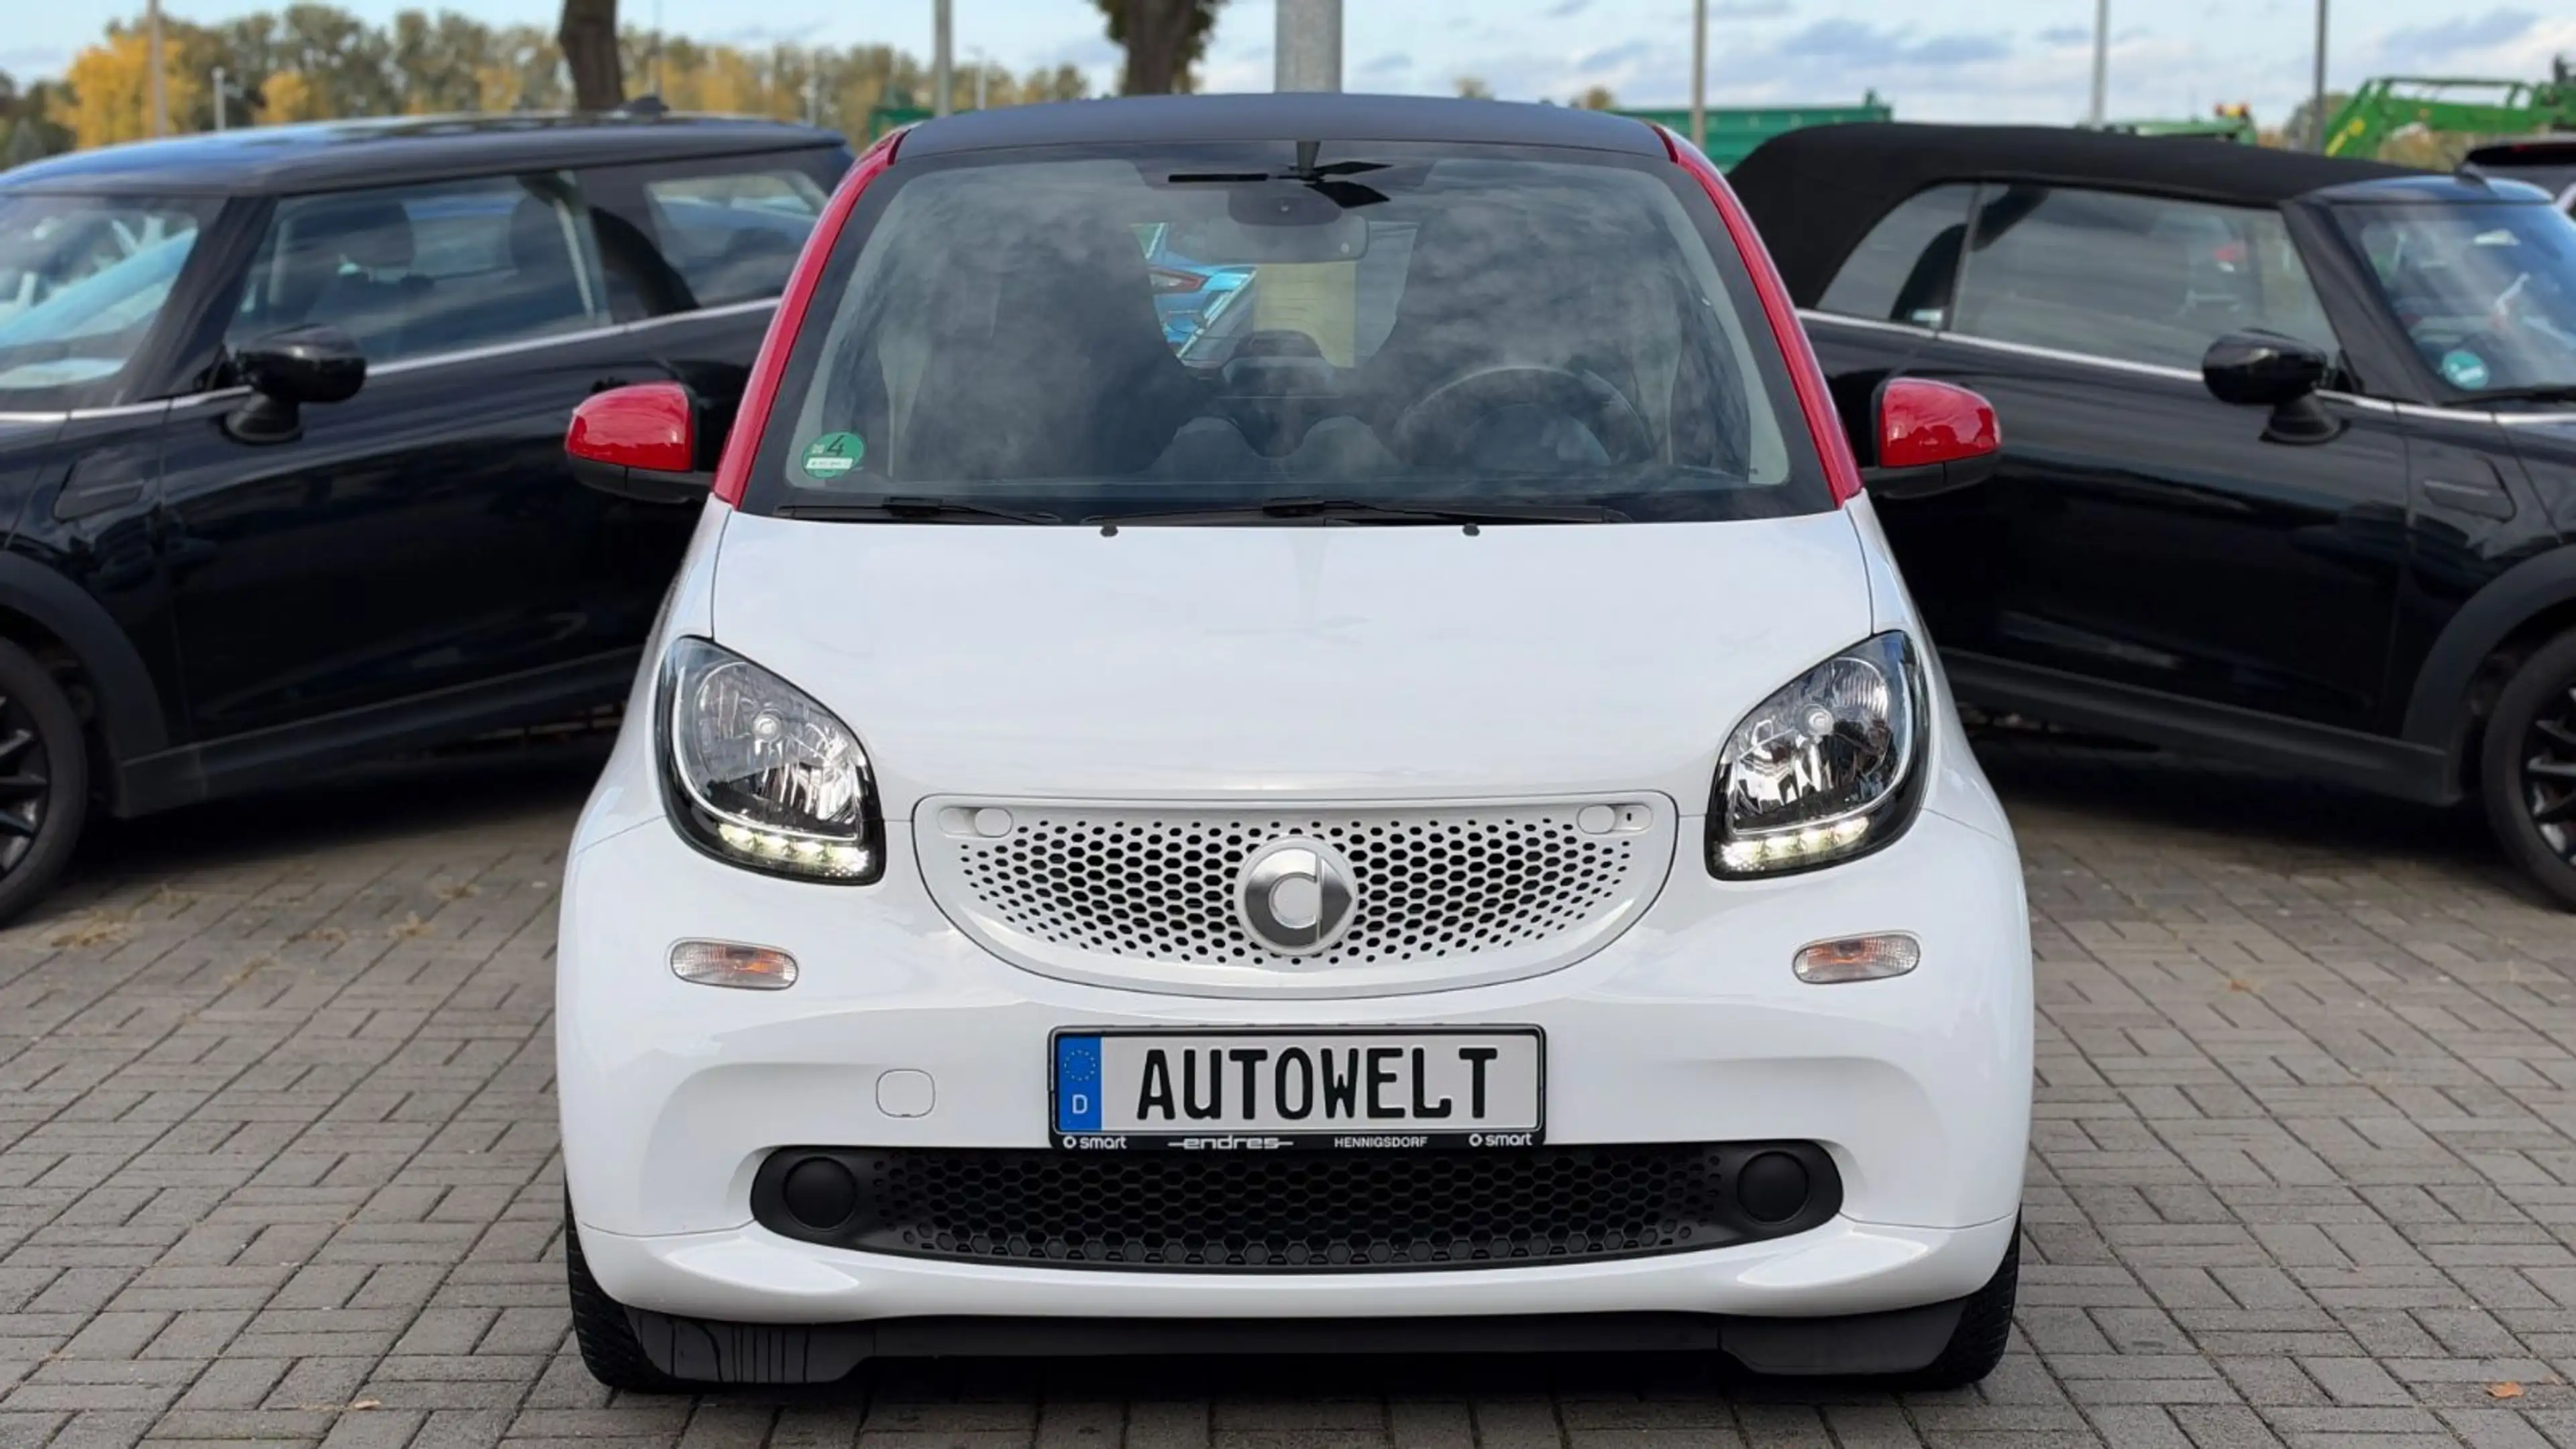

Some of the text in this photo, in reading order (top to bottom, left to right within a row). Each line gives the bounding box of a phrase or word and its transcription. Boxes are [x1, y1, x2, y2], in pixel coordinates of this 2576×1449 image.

[826, 435, 845, 455] 4
[1136, 1046, 1498, 1120] AUTOWELT
[1072, 1093, 1088, 1114] D
[1079, 1136, 1127, 1150] smart
[1183, 1134, 1281, 1150] endres
[1334, 1136, 1428, 1148] HENNIGSDORF
[1485, 1132, 1533, 1146] smart
